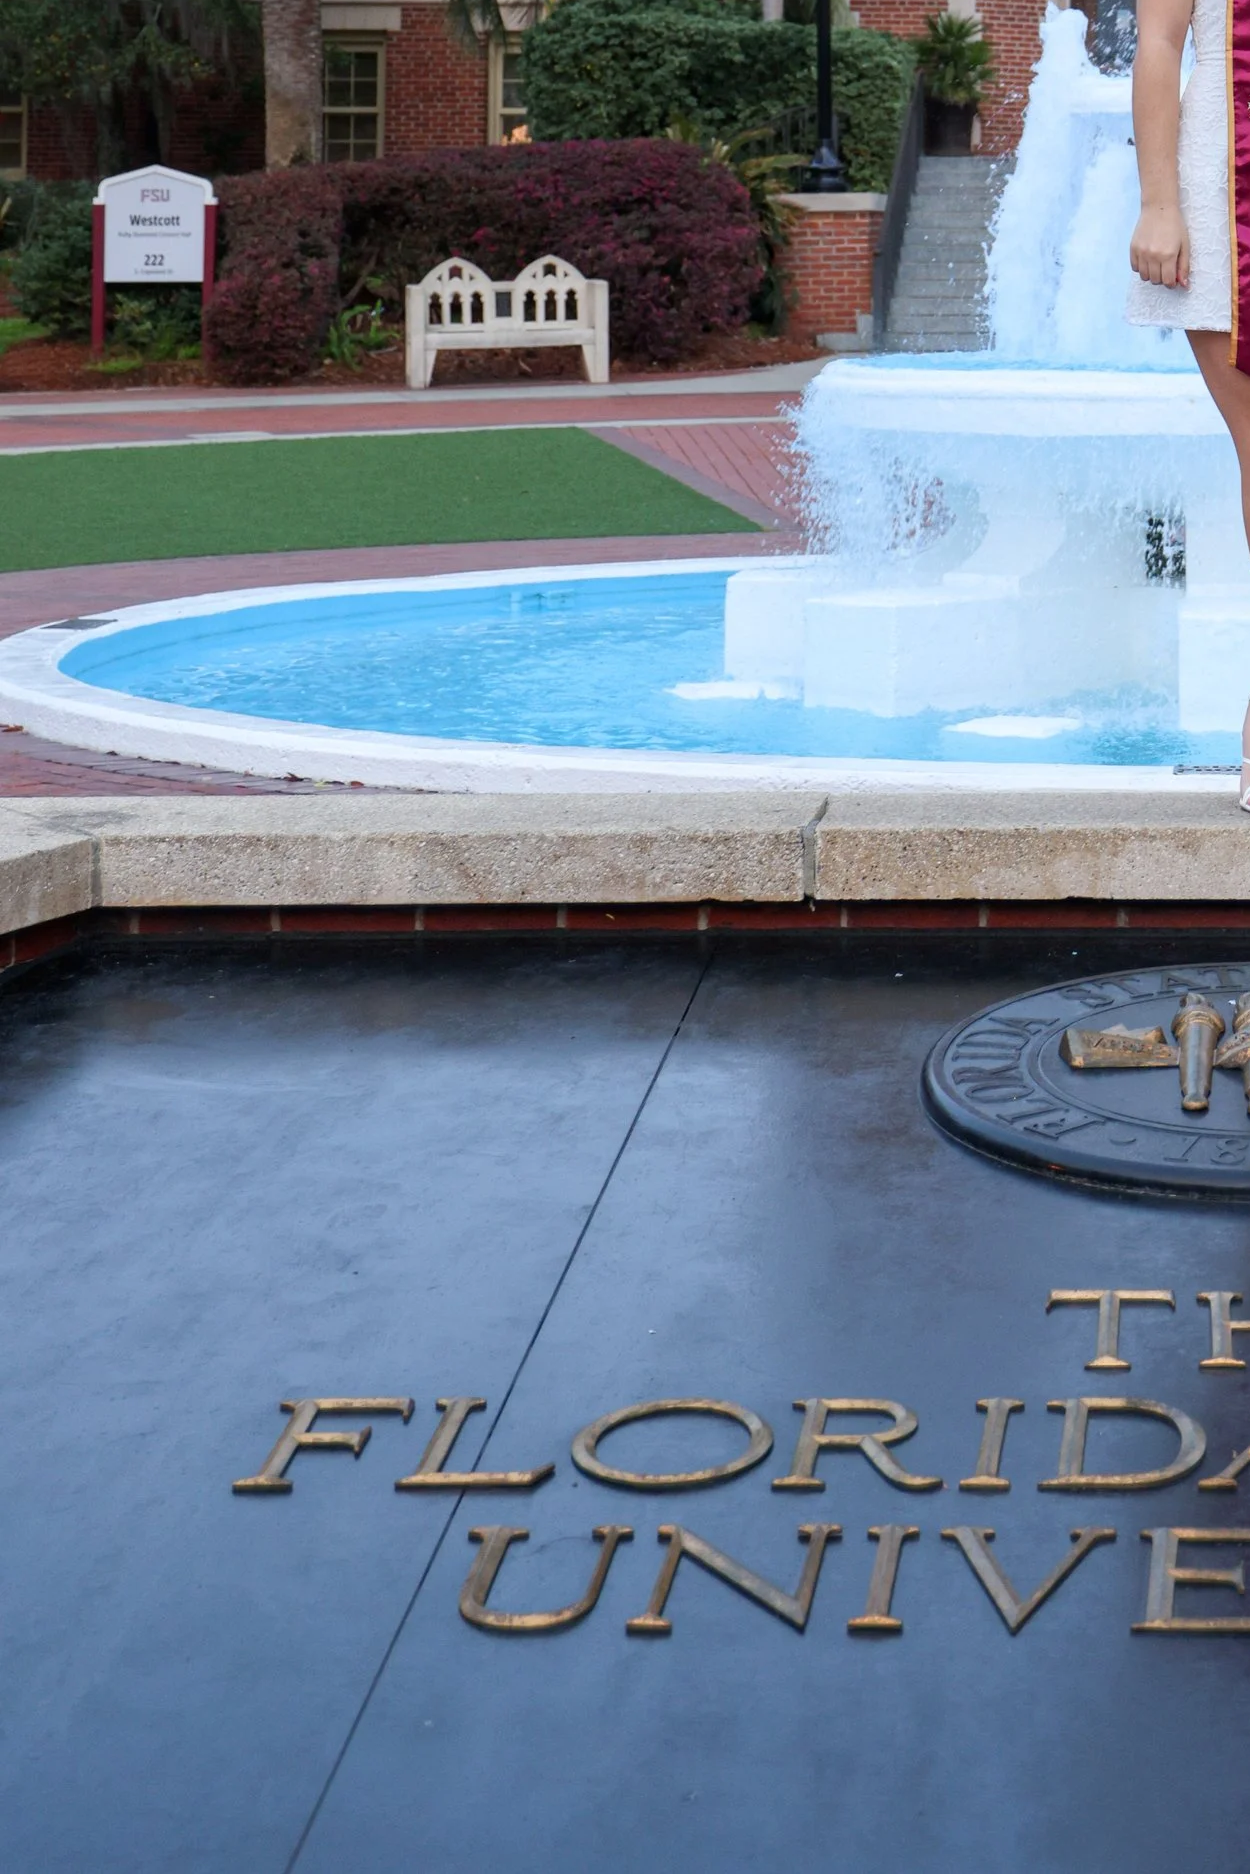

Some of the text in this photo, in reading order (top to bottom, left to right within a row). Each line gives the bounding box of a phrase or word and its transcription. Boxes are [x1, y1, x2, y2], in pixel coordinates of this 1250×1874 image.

[140, 188, 170, 203] FSU
[129, 214, 181, 227] Westcott
[143, 254, 165, 267] 222
[951, 1016, 1108, 1140] FLORIDA
